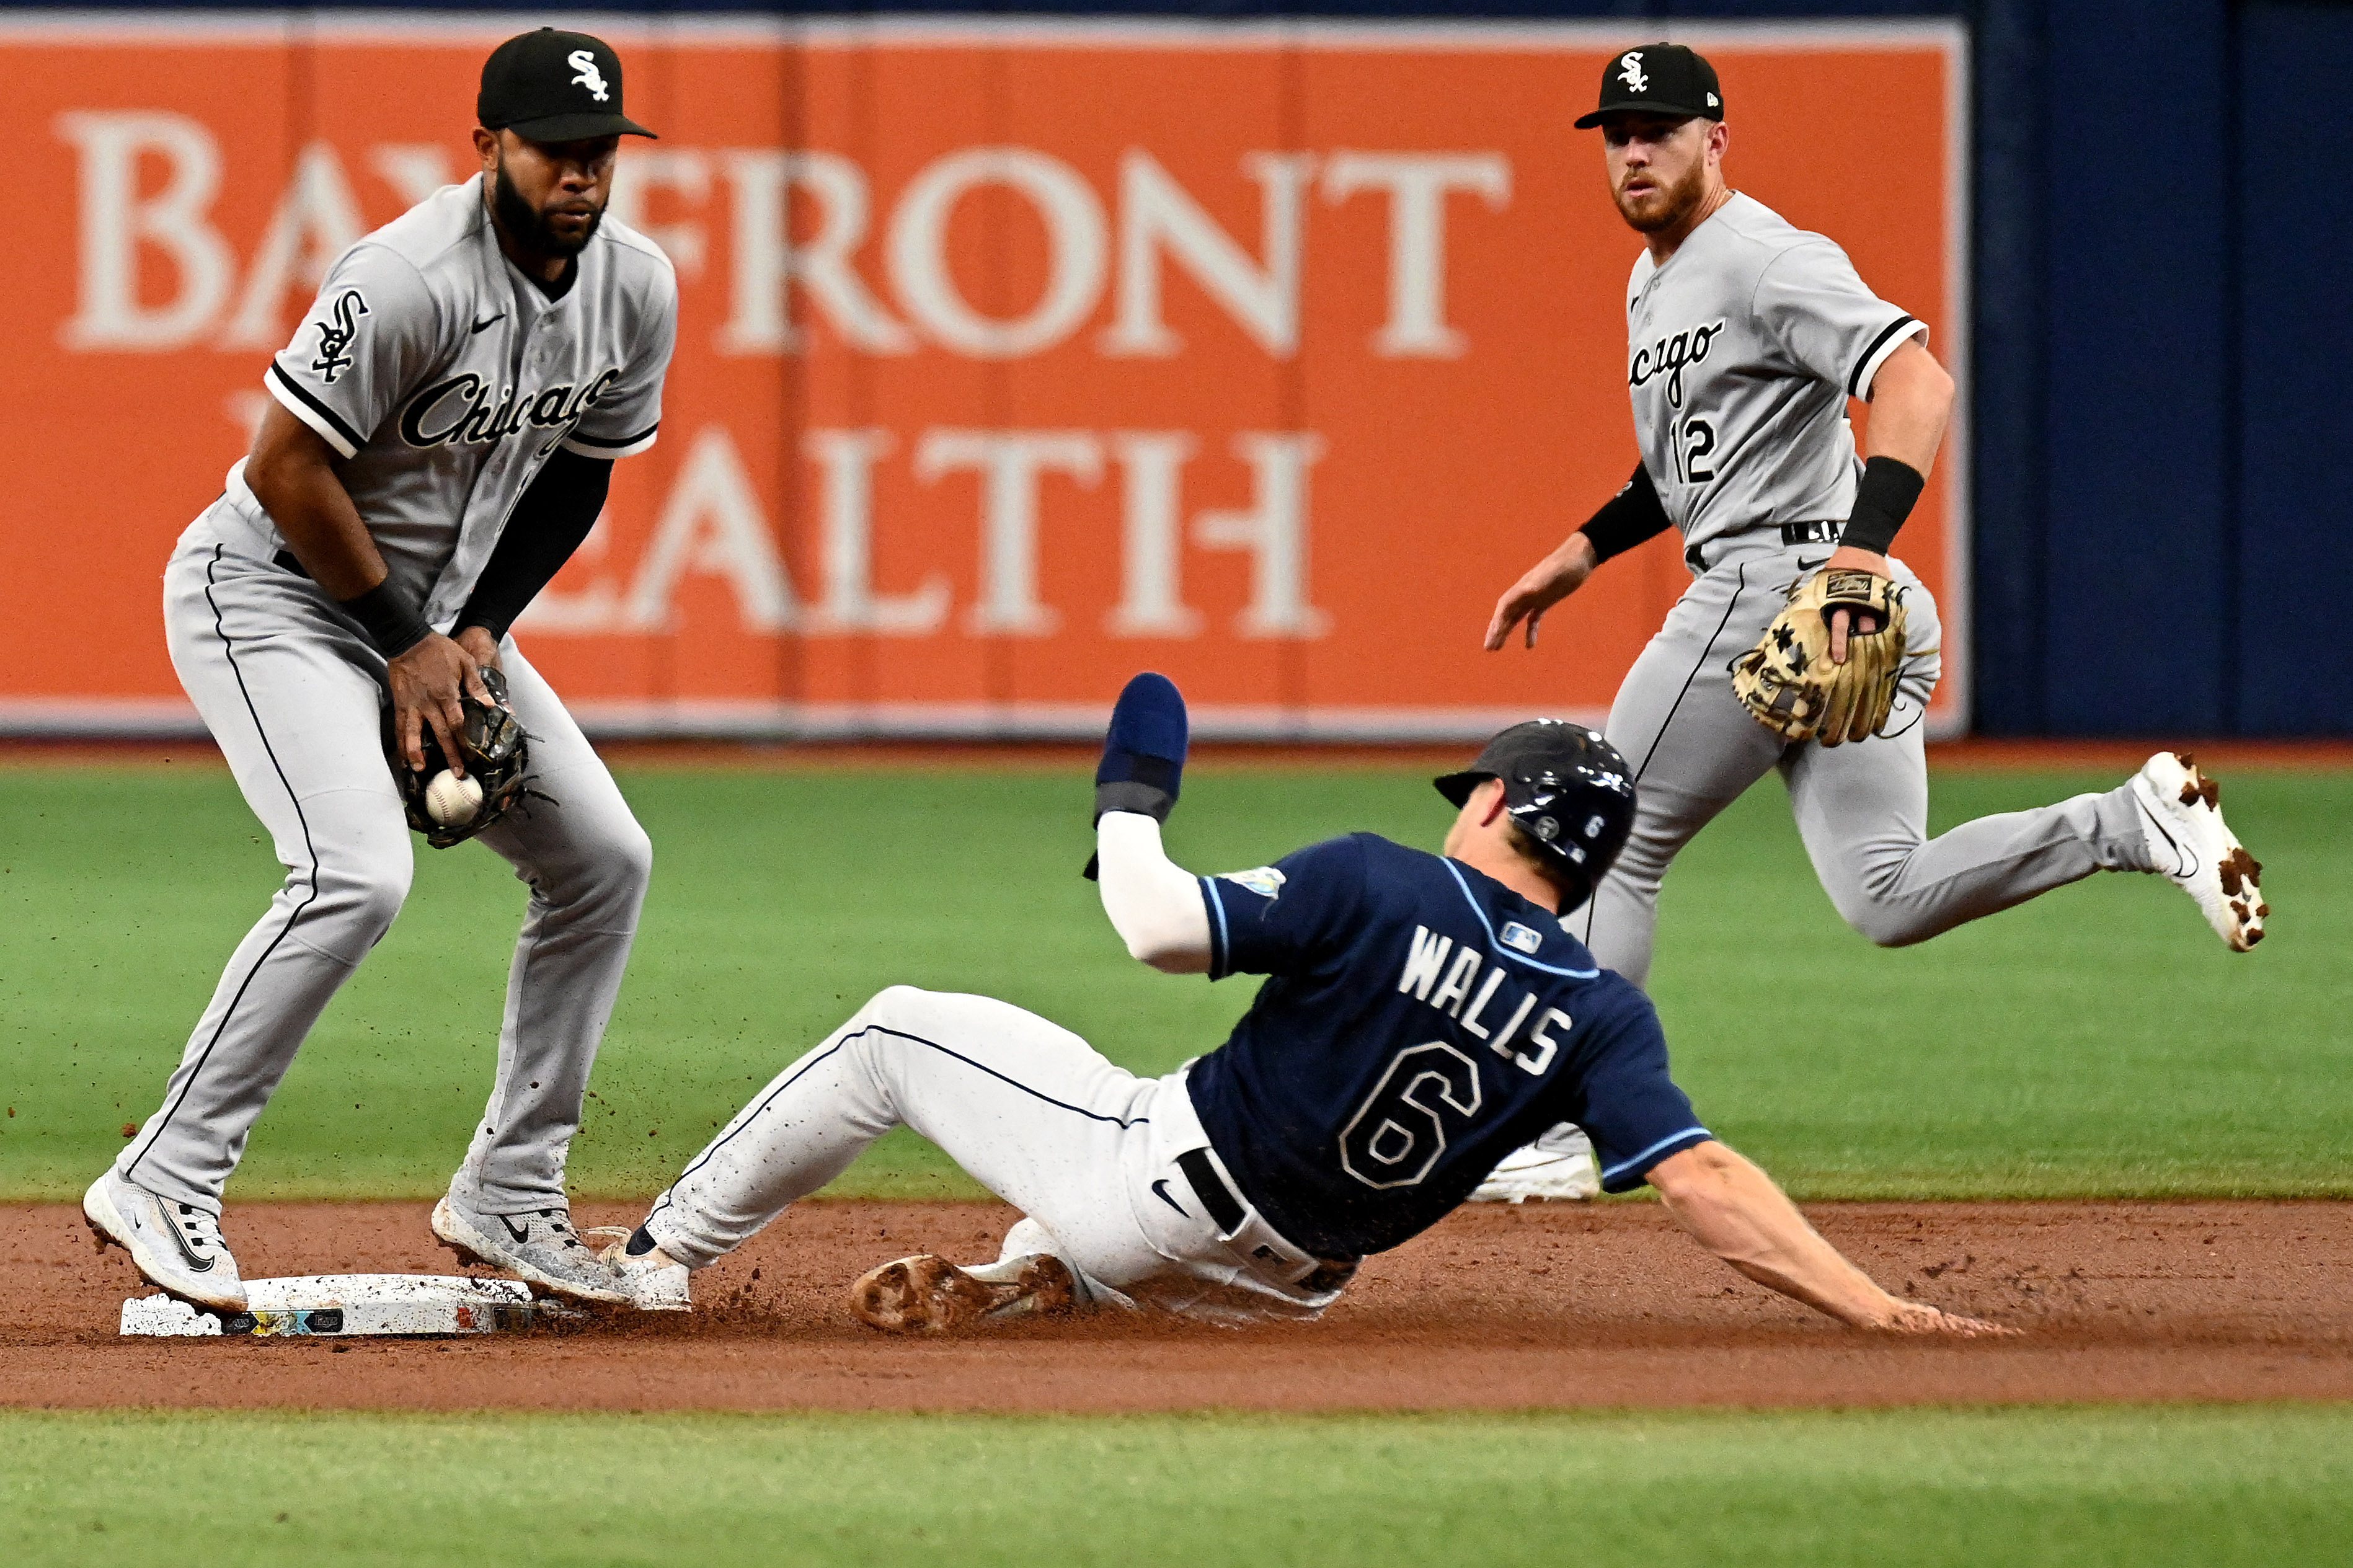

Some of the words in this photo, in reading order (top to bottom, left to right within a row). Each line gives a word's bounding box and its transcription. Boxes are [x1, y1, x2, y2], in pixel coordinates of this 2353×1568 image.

[228, 393, 1333, 639] ALTH
[1670, 415, 1717, 485] 12
[1585, 814, 1605, 838] 6
[1398, 925, 1572, 1076] WALLS
[1338, 1040, 1482, 1190] 6
